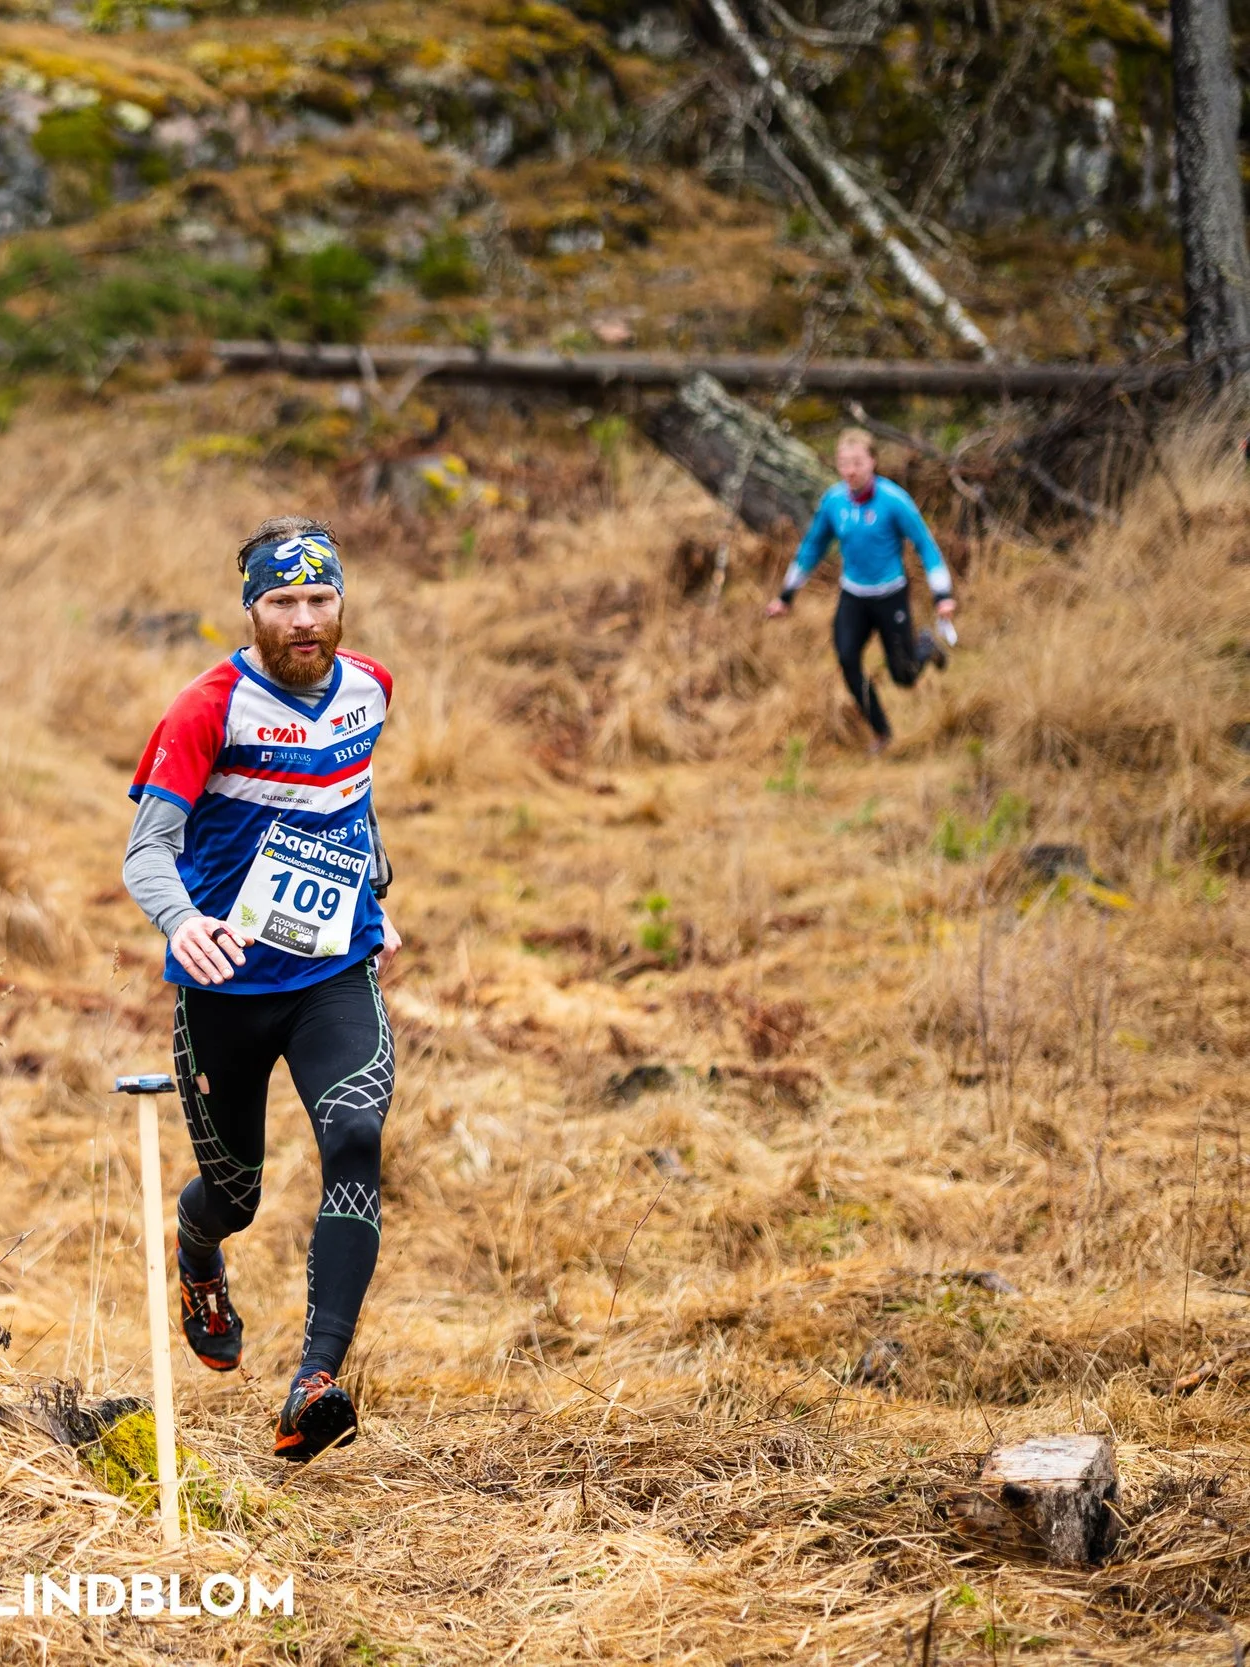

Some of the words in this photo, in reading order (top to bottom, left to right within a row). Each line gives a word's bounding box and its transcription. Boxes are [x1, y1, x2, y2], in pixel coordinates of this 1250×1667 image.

[346, 705, 367, 728] IVT
[257, 723, 307, 744] emit
[333, 738, 372, 763] BIOS
[261, 793, 313, 805] BILLERUDKORSNÄS
[269, 825, 365, 874] bagheera
[270, 871, 341, 921] 109
[273, 916, 314, 937] GODKÄNDA
